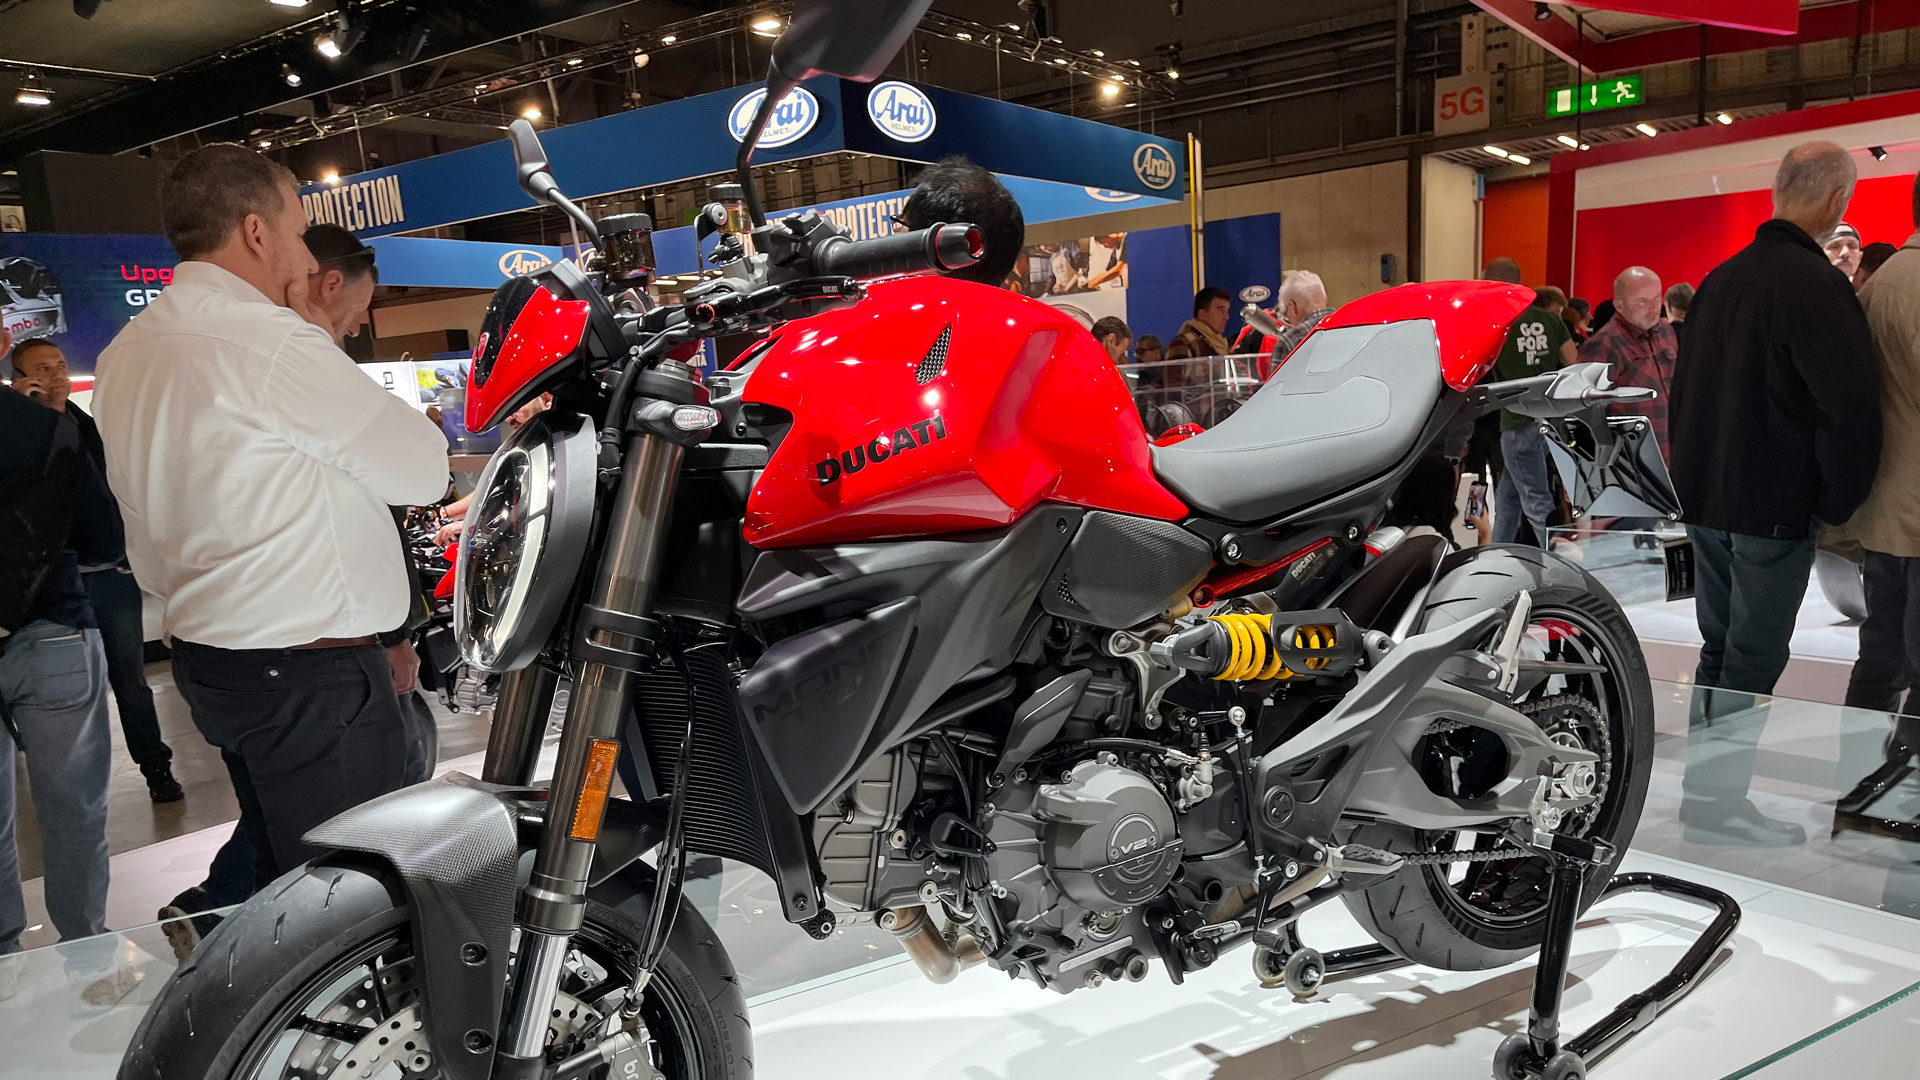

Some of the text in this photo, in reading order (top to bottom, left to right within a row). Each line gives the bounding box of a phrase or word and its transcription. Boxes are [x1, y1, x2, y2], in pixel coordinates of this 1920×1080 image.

[875, 89, 926, 126] Arai
[1440, 86, 1484, 121] 5G
[762, 127, 789, 138] ELMET
[1137, 147, 1170, 178] Arai
[301, 174, 405, 232] PROTECTION
[121, 264, 174, 285] Upg
[1520, 321, 1545, 337] GO
[1517, 334, 1549, 352] FOR
[816, 414, 947, 487] DUCATI
[1291, 552, 1316, 578] DUCATI
[1120, 838, 1148, 854] V2
